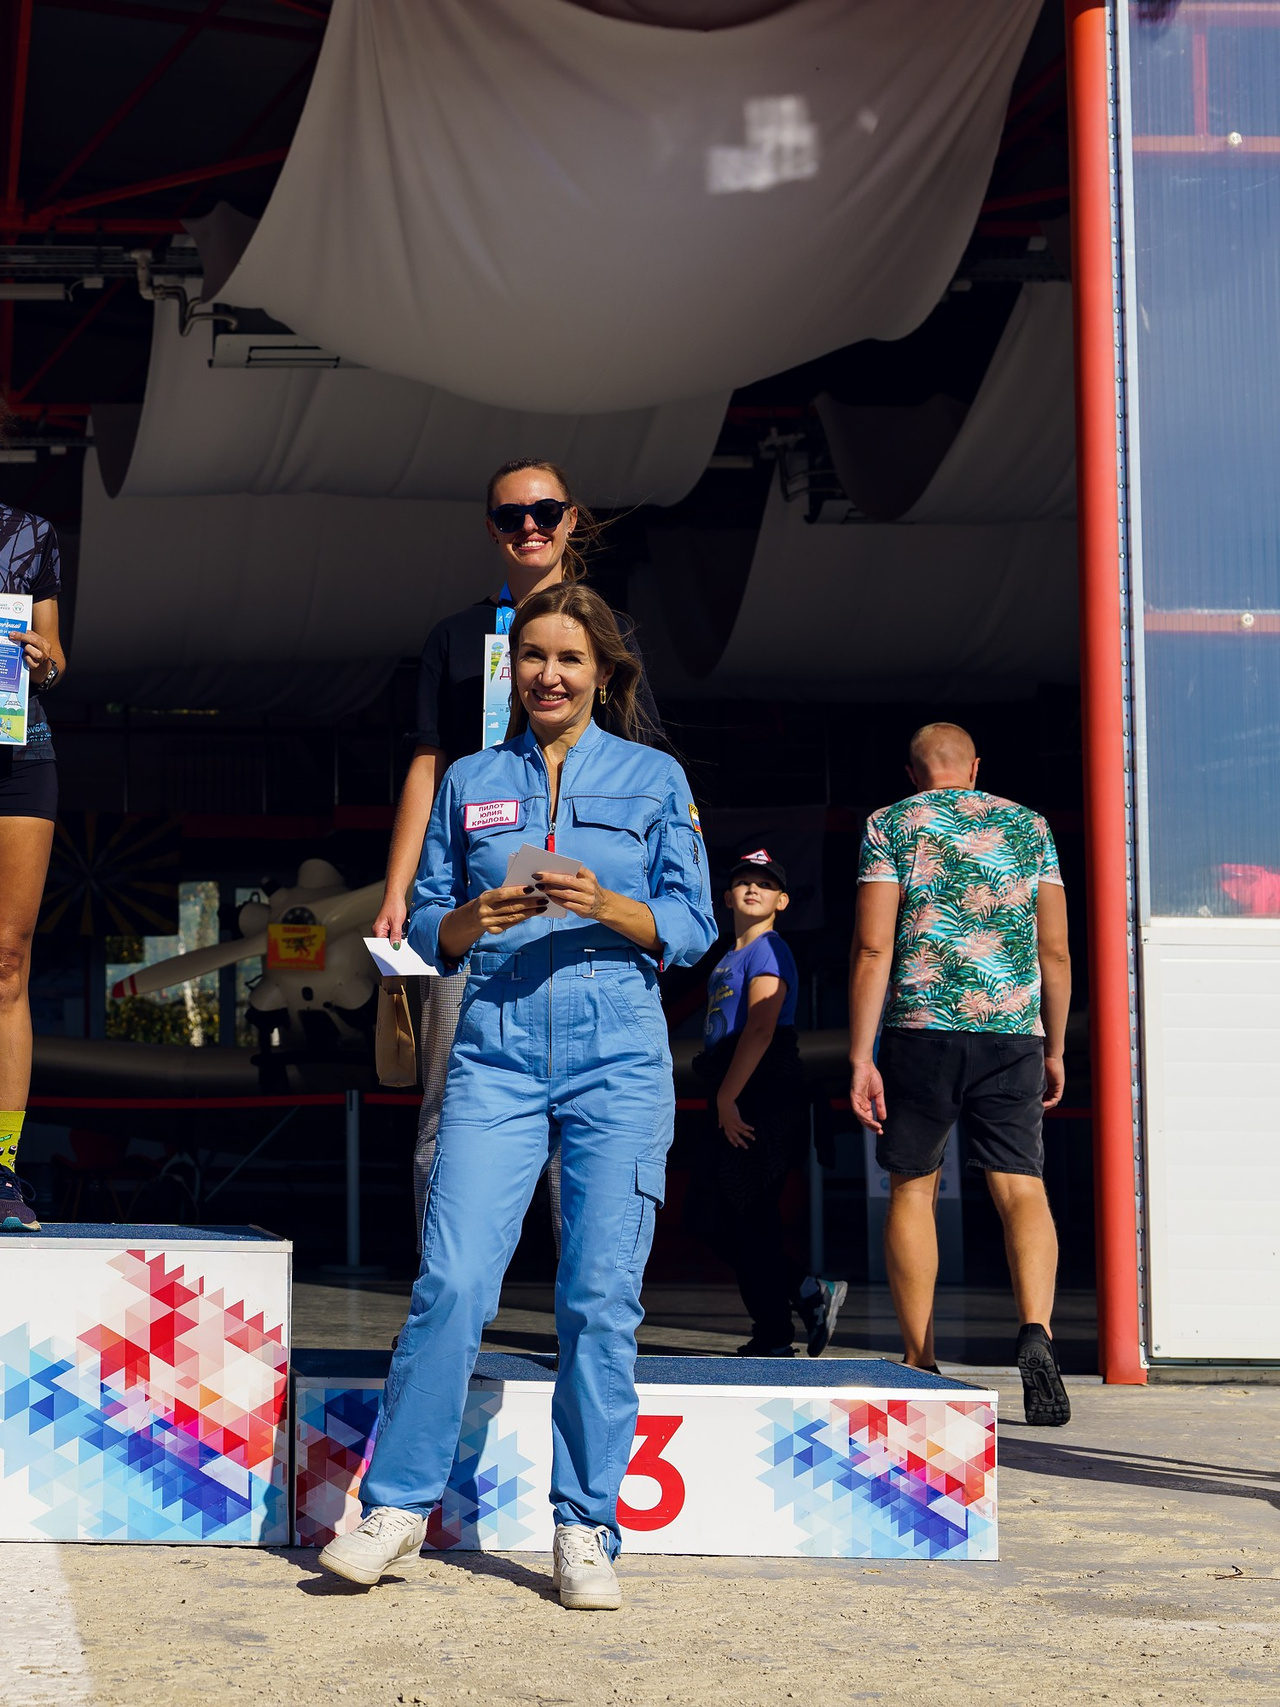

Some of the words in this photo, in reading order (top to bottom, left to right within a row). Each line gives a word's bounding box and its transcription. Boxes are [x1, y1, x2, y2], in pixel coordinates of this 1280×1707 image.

[478, 803, 505, 812] ПИЛОТ
[479, 809, 503, 818] ЮЛИЯ
[471, 816, 510, 827] КРЫЛОВА
[619, 1414, 686, 1532] 3
